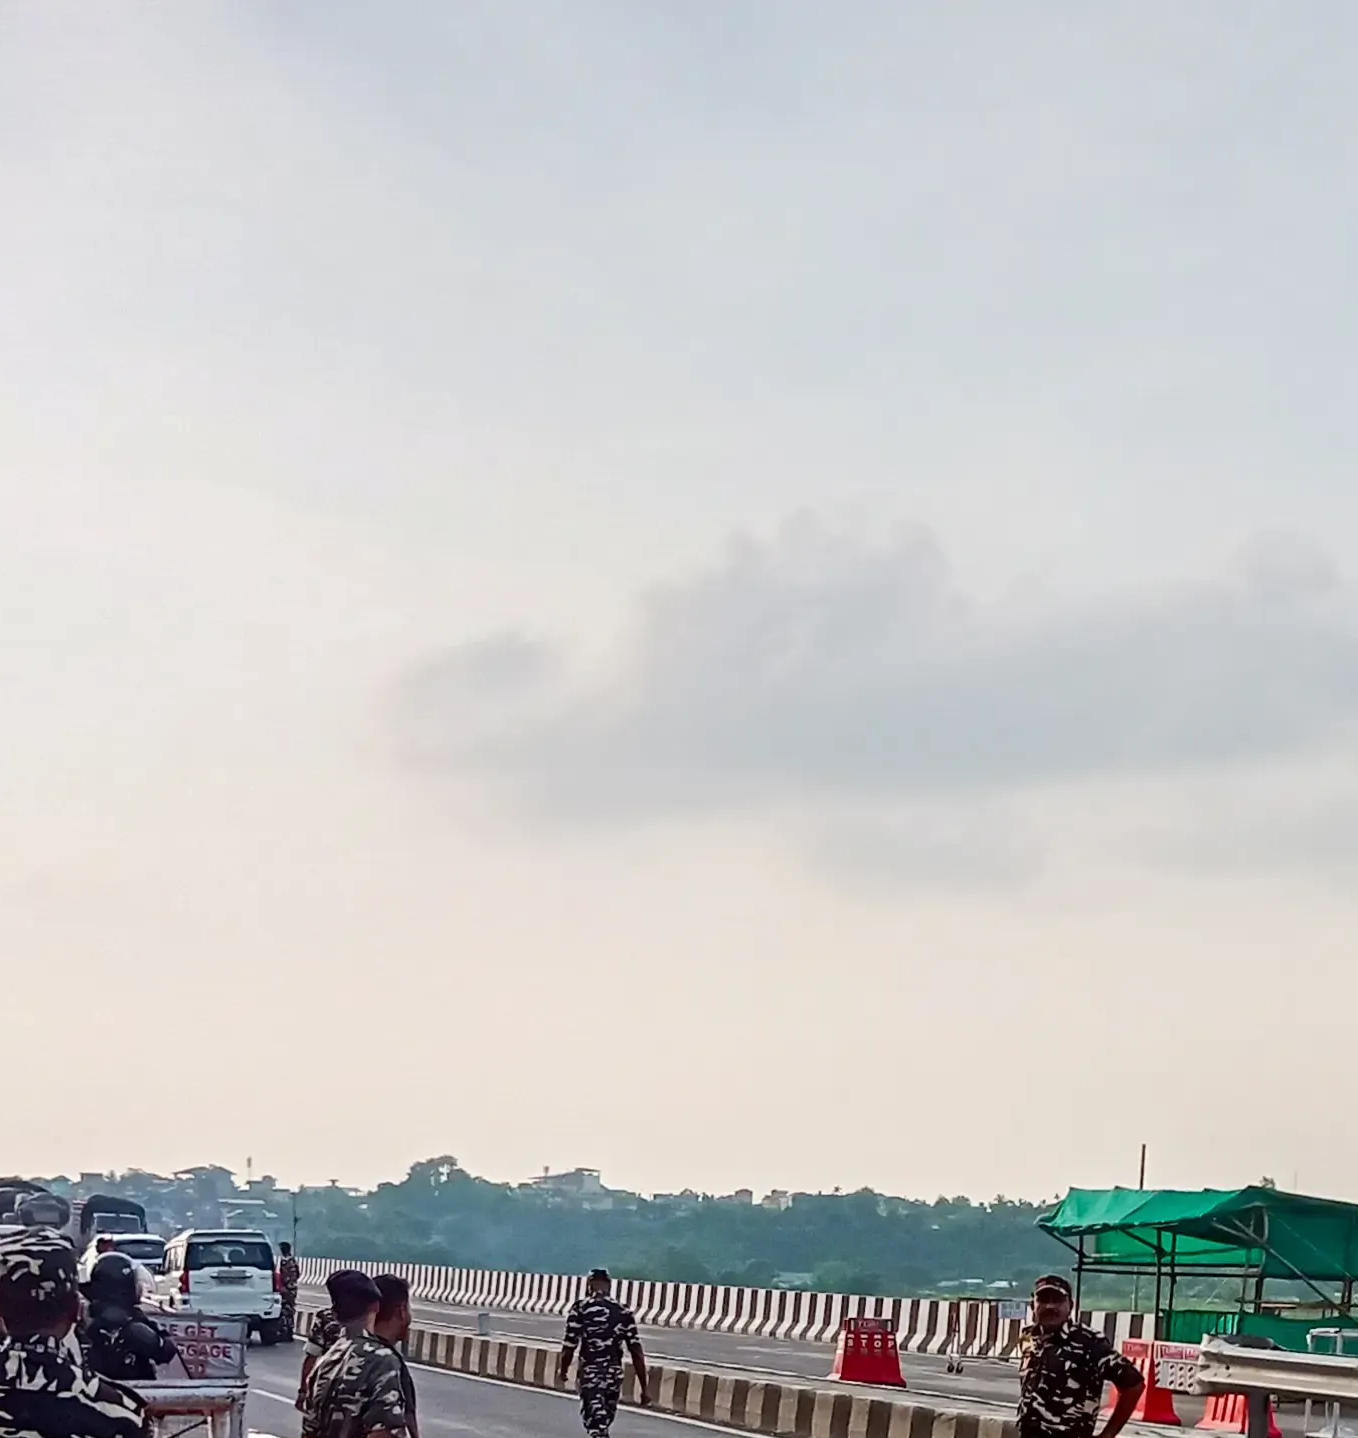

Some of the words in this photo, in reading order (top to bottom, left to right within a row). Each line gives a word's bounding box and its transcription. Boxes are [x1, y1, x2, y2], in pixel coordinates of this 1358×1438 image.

[185, 1325, 218, 1338] GET
[847, 1339, 894, 1348] STOP
[177, 1343, 232, 1358] GGAGE
